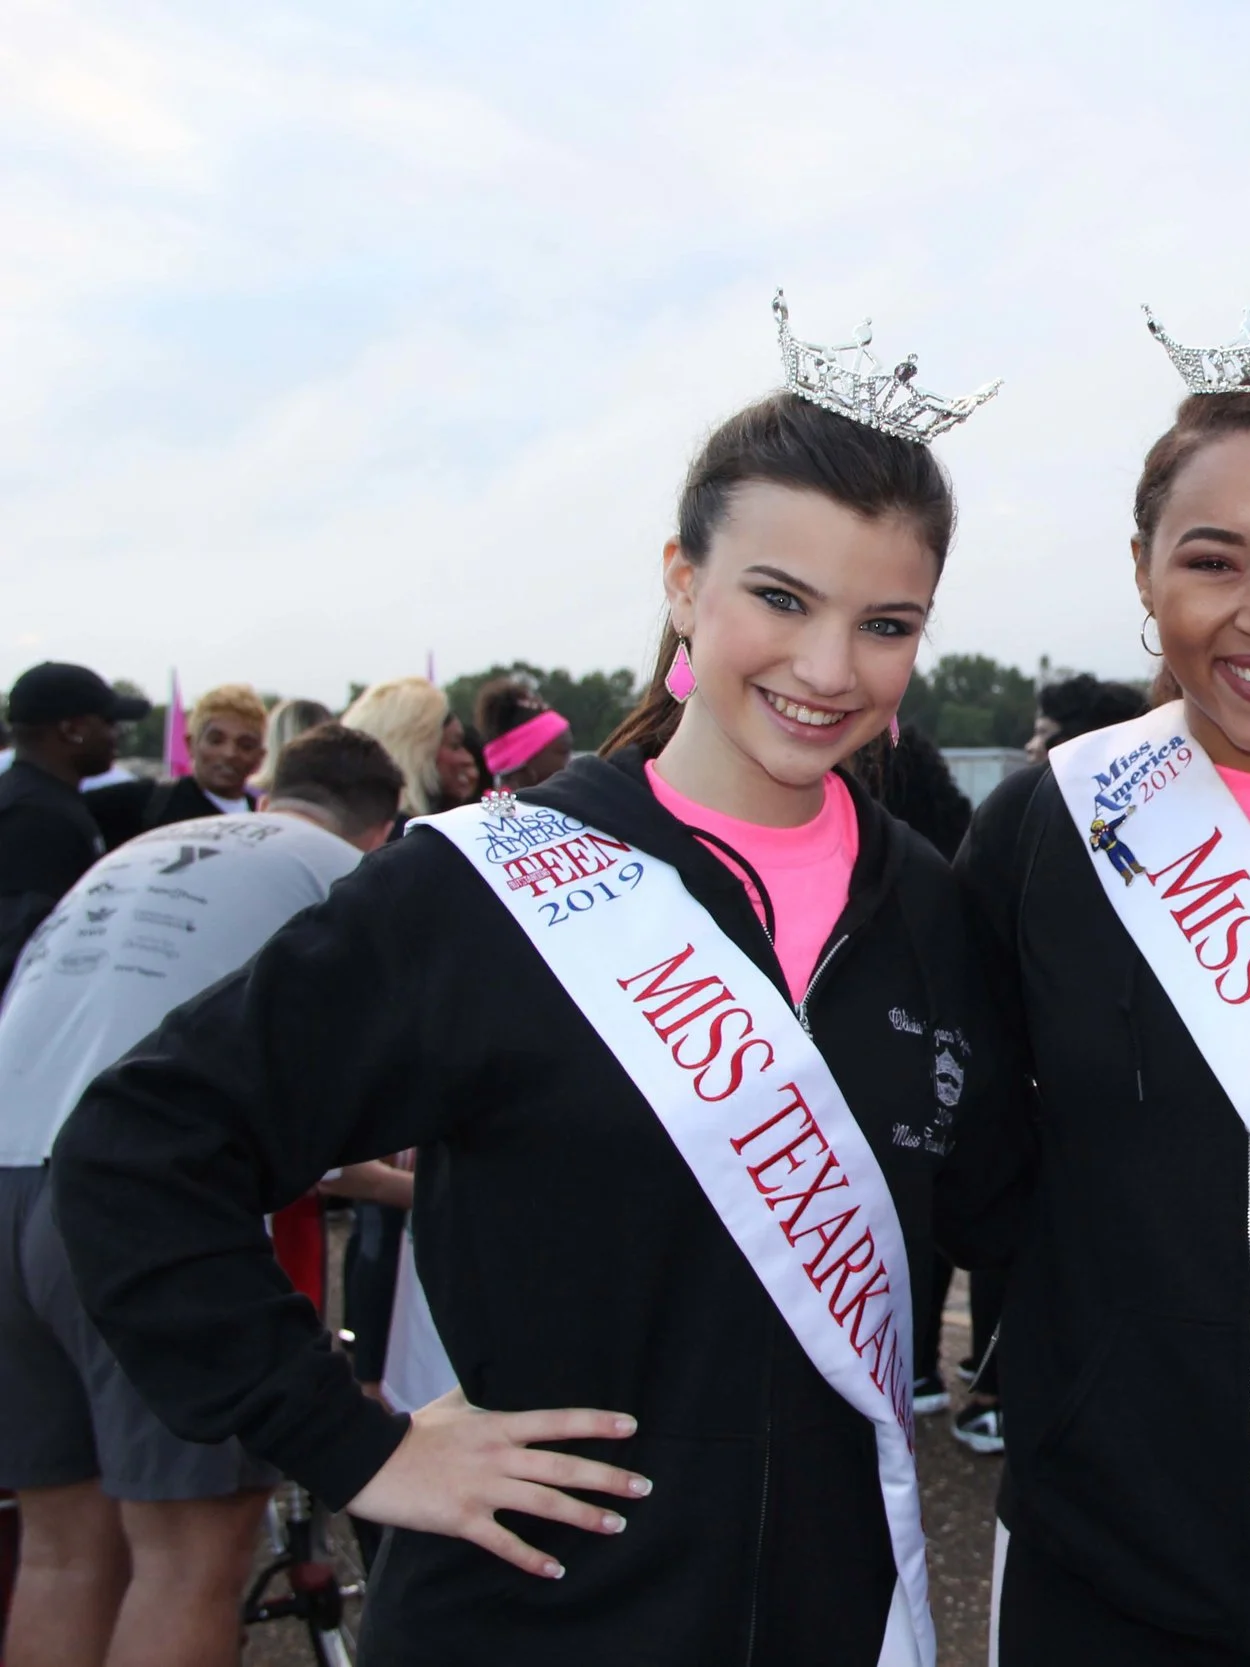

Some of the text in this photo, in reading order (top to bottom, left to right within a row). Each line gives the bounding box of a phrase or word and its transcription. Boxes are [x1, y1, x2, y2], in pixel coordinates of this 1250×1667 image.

[1092, 741, 1151, 793] Miss
[1094, 736, 1187, 819] America
[1139, 747, 1193, 804] 2019
[479, 809, 556, 838] MISS
[502, 832, 632, 898] TEEN
[537, 861, 645, 928] 2019
[617, 942, 775, 1103] MISS
